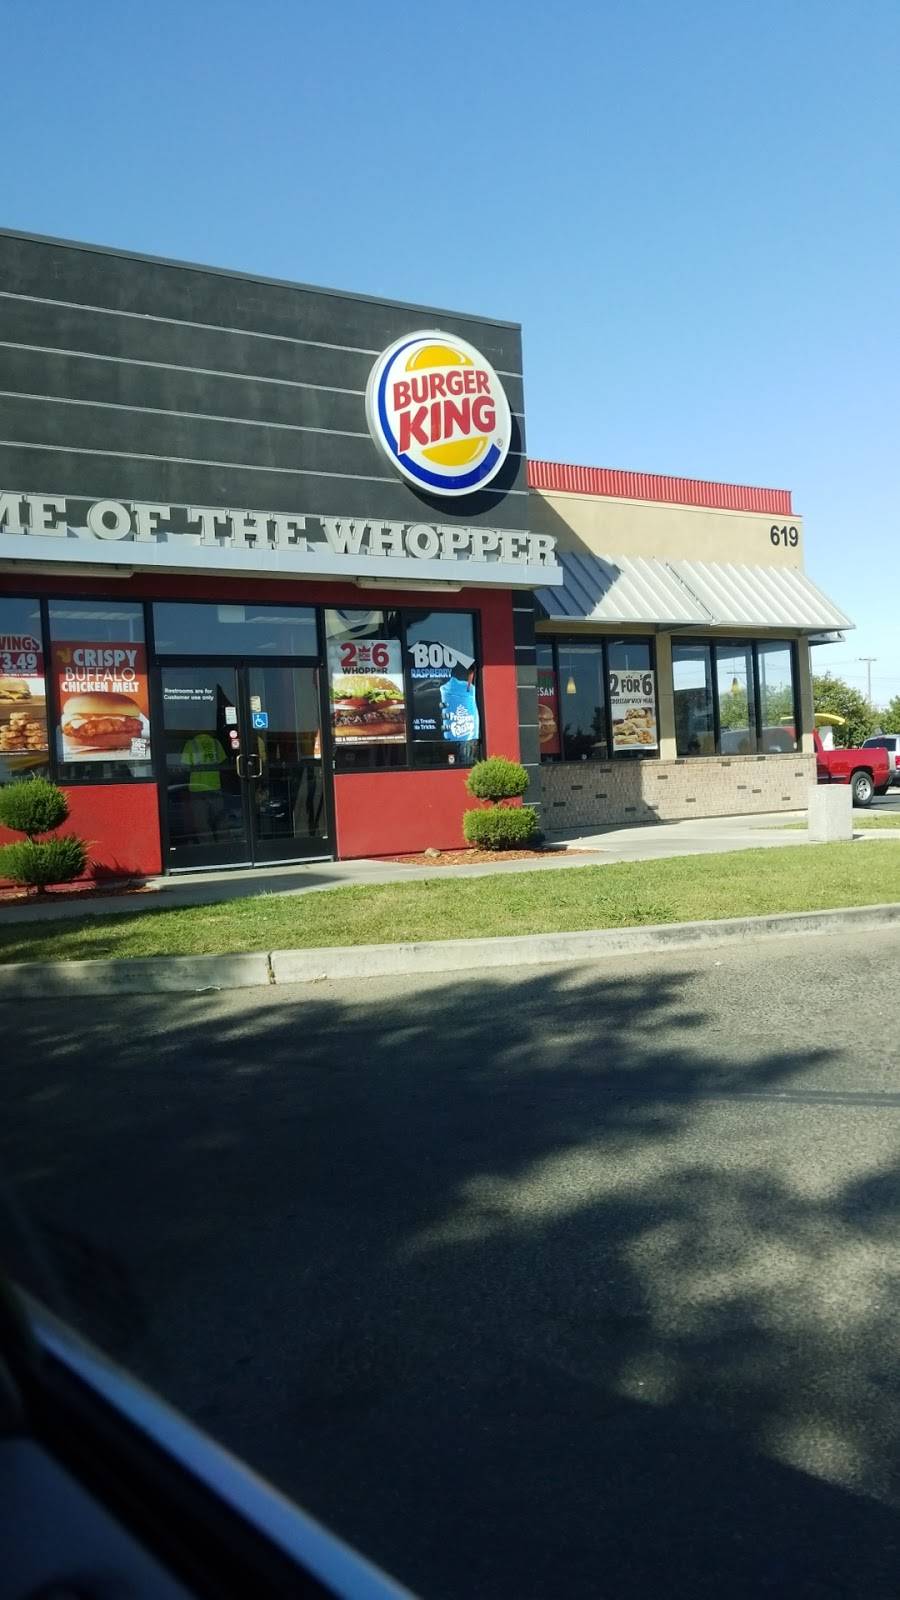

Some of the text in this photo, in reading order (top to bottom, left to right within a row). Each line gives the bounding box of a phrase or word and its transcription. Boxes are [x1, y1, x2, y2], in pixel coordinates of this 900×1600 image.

[393, 370, 491, 411] BURGER
[399, 395, 496, 453] KING
[87, 499, 170, 543] OF
[187, 506, 306, 552] THE
[320, 516, 557, 567] WHOPPER
[770, 525, 799, 547] 619
[73, 648, 137, 667] CRISPY
[340, 642, 358, 667] 2
[408, 642, 459, 669] BOO
[64, 666, 136, 682] BUFFALO
[411, 668, 452, 678] RASPBERRY
[609, 673, 620, 697] 2
[620, 678, 641, 693] FOR
[61, 681, 140, 692] CHICKEN MELT
